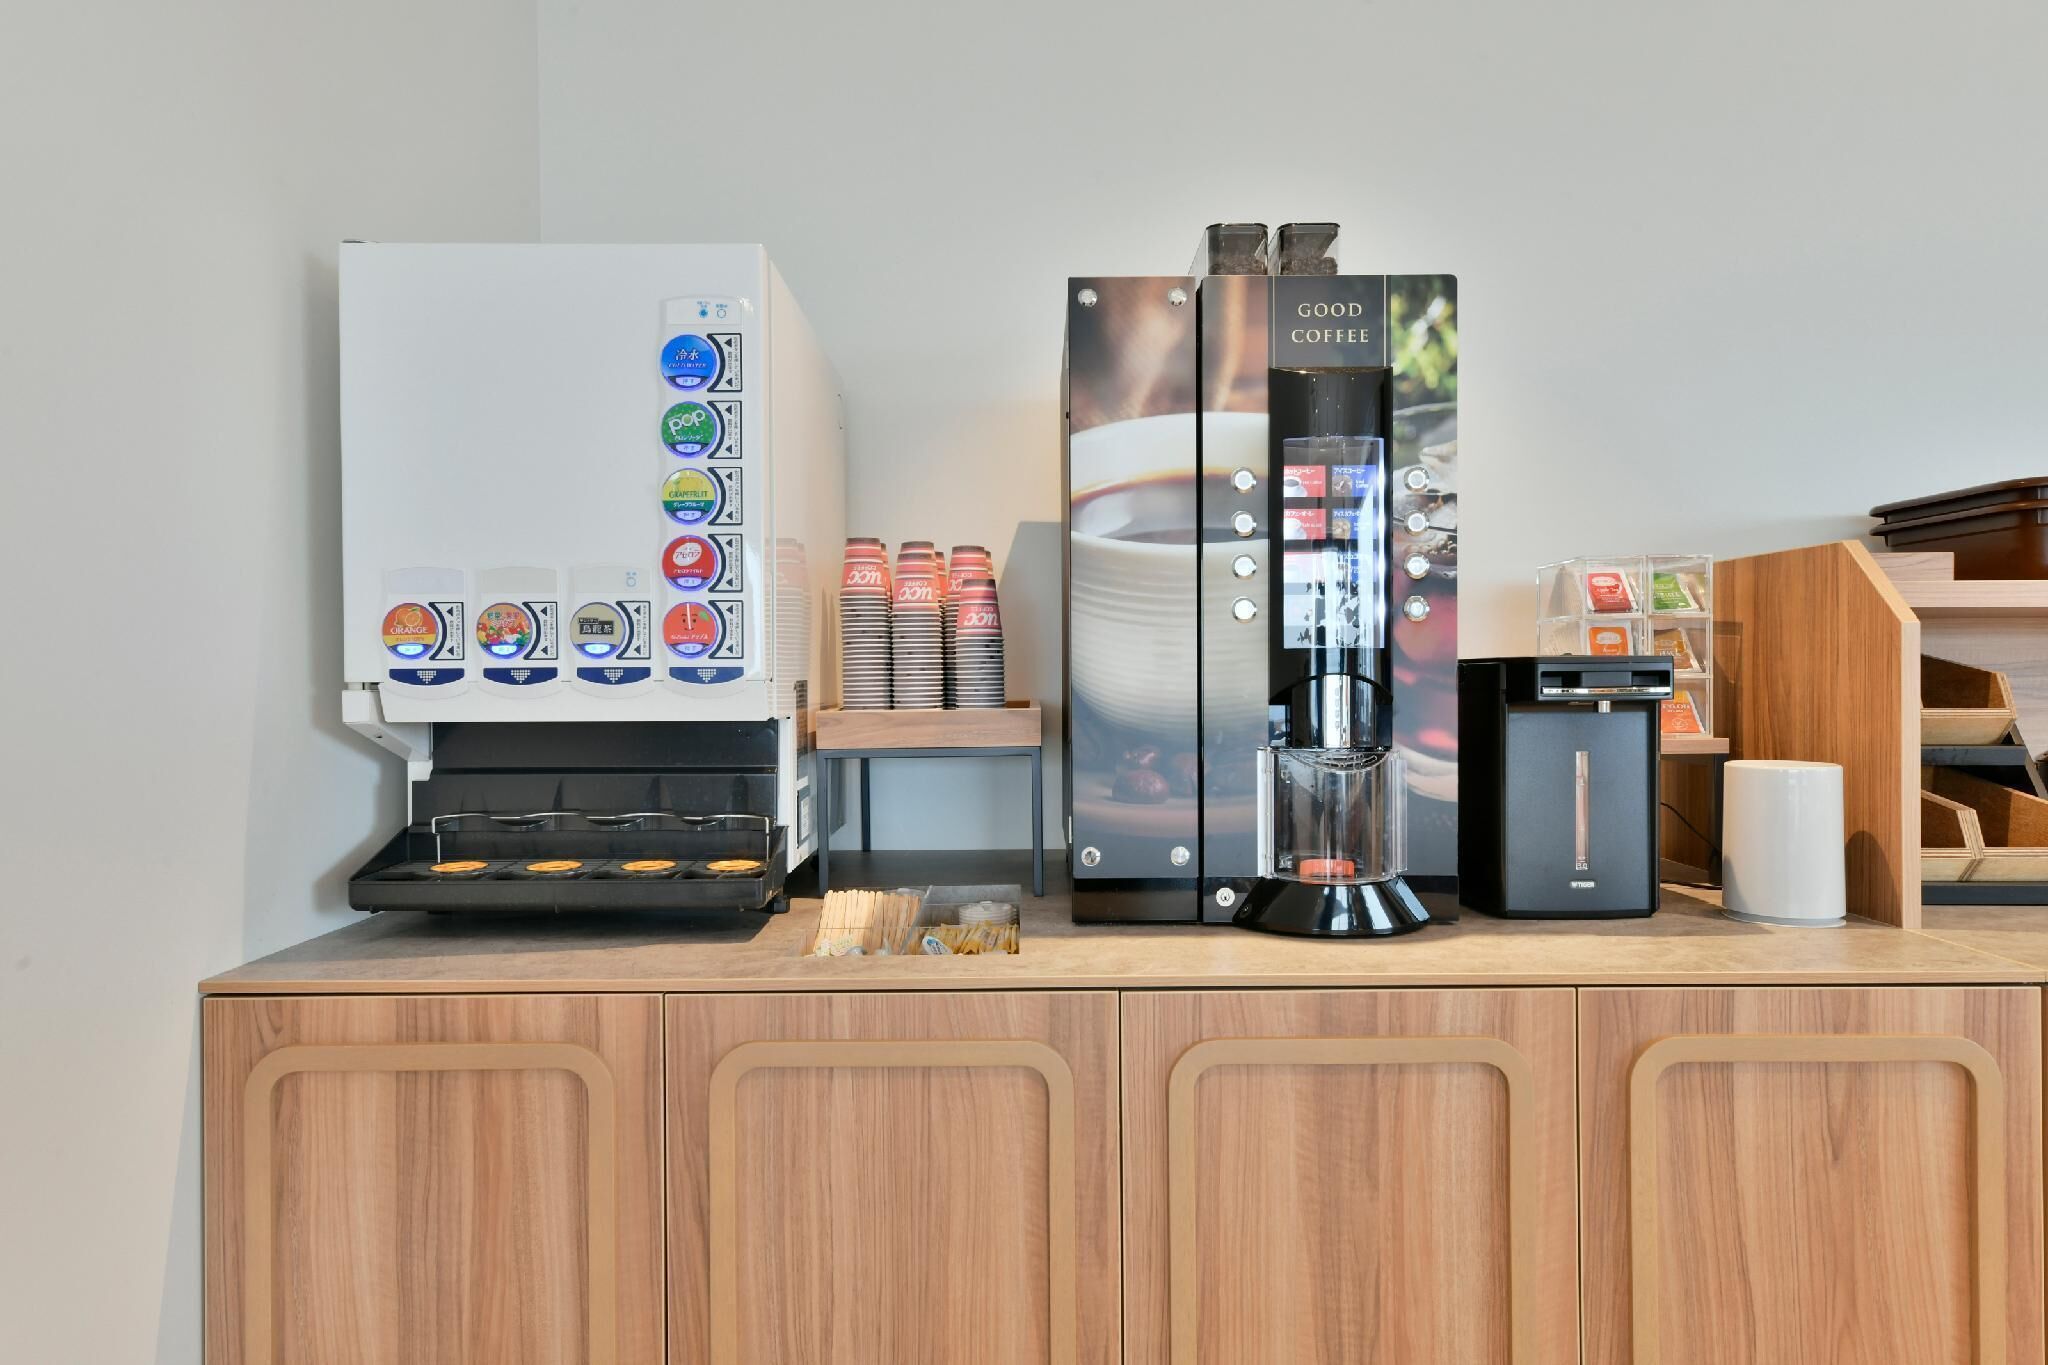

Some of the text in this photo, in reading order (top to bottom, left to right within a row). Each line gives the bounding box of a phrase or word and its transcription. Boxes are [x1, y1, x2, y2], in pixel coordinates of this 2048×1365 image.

[1298, 303, 1362, 317] GOOD
[1291, 329, 1369, 343] COFFEE
[675, 349, 699, 361] 冷水
[668, 409, 706, 436] pop
[669, 490, 708, 499] GRAPEFRUIT
[847, 570, 882, 585] UCC
[898, 587, 933, 601] UCC
[963, 613, 998, 626] UCC
[390, 626, 428, 635] ORANGE
[581, 624, 613, 635] 烏龍茶
